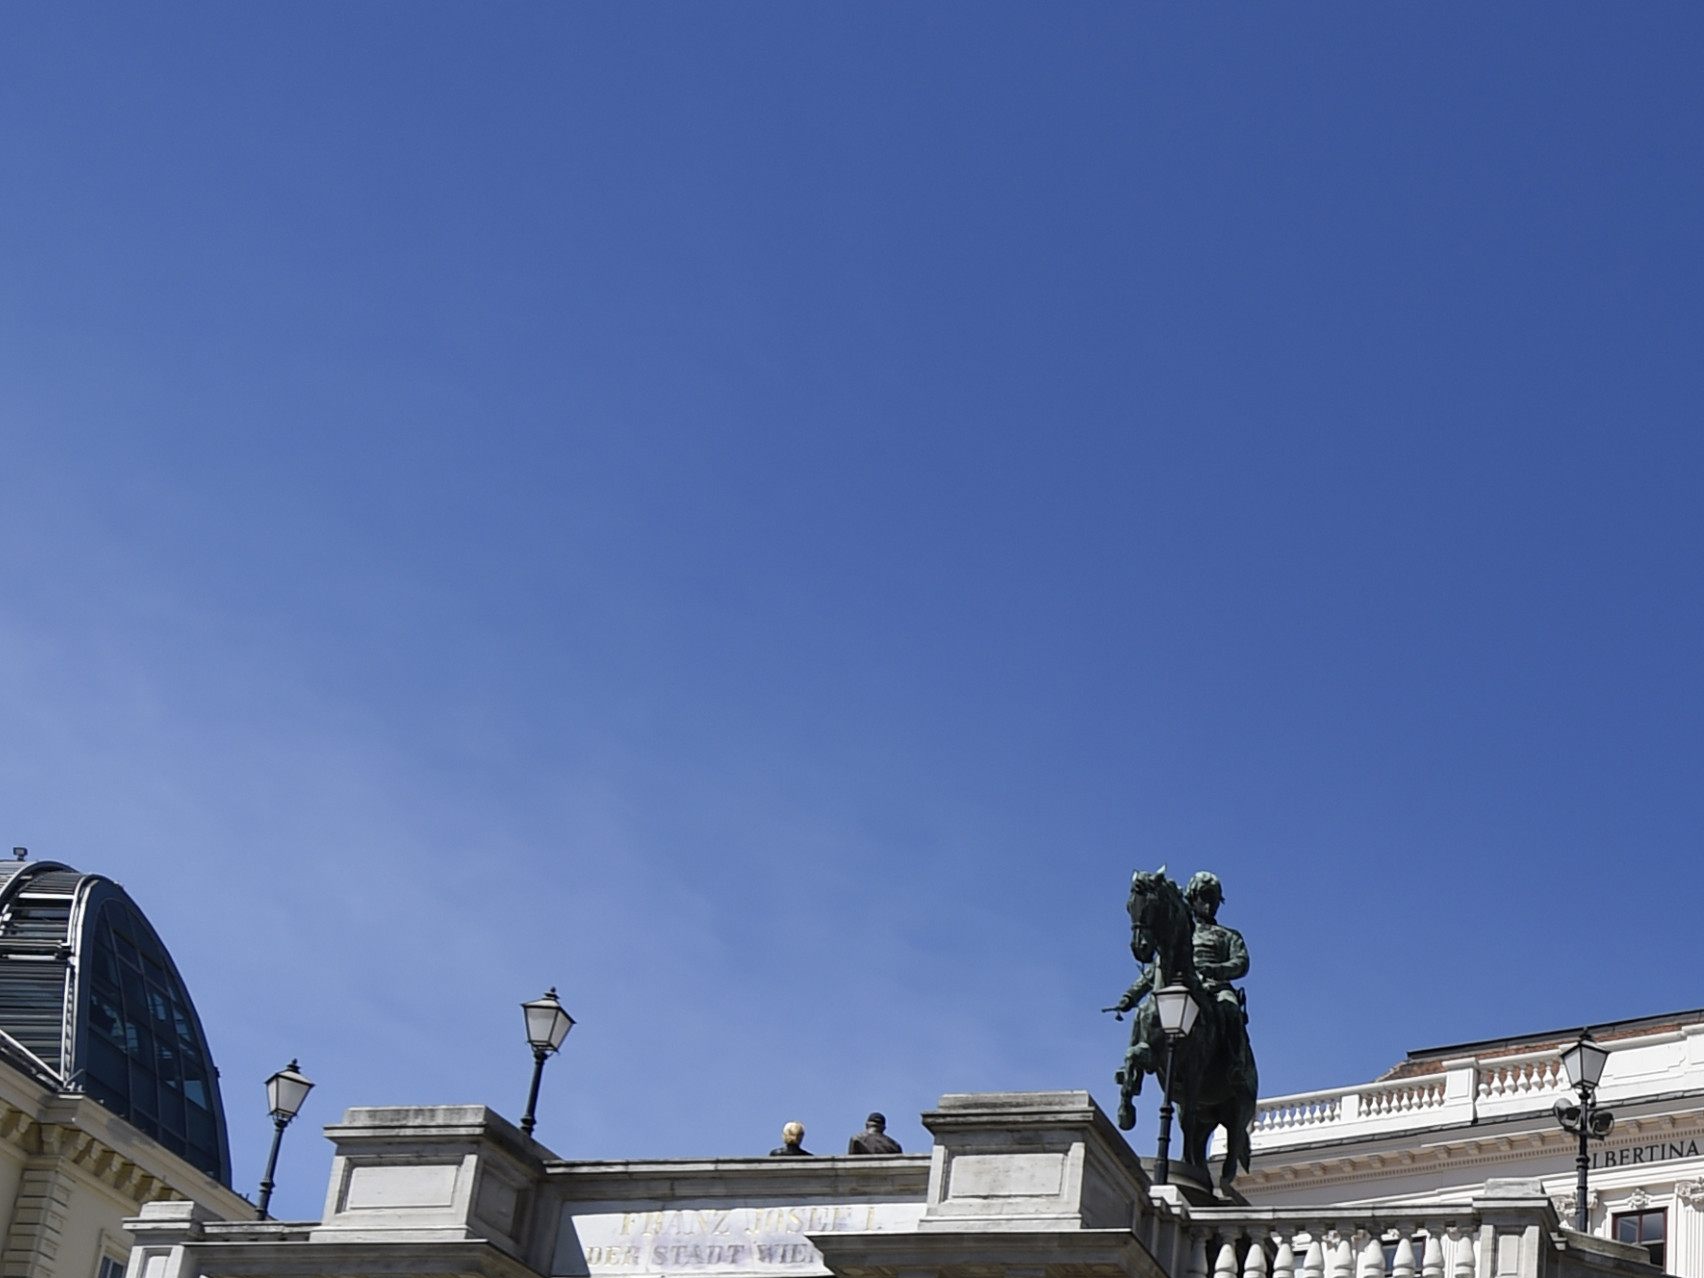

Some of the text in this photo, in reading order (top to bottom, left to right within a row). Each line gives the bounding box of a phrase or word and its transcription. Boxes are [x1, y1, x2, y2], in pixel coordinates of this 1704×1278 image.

[1593, 1140, 1699, 1169] LBERTINA
[618, 1209, 731, 1236] FRANZ
[587, 1243, 816, 1266] DER STADT WIE
